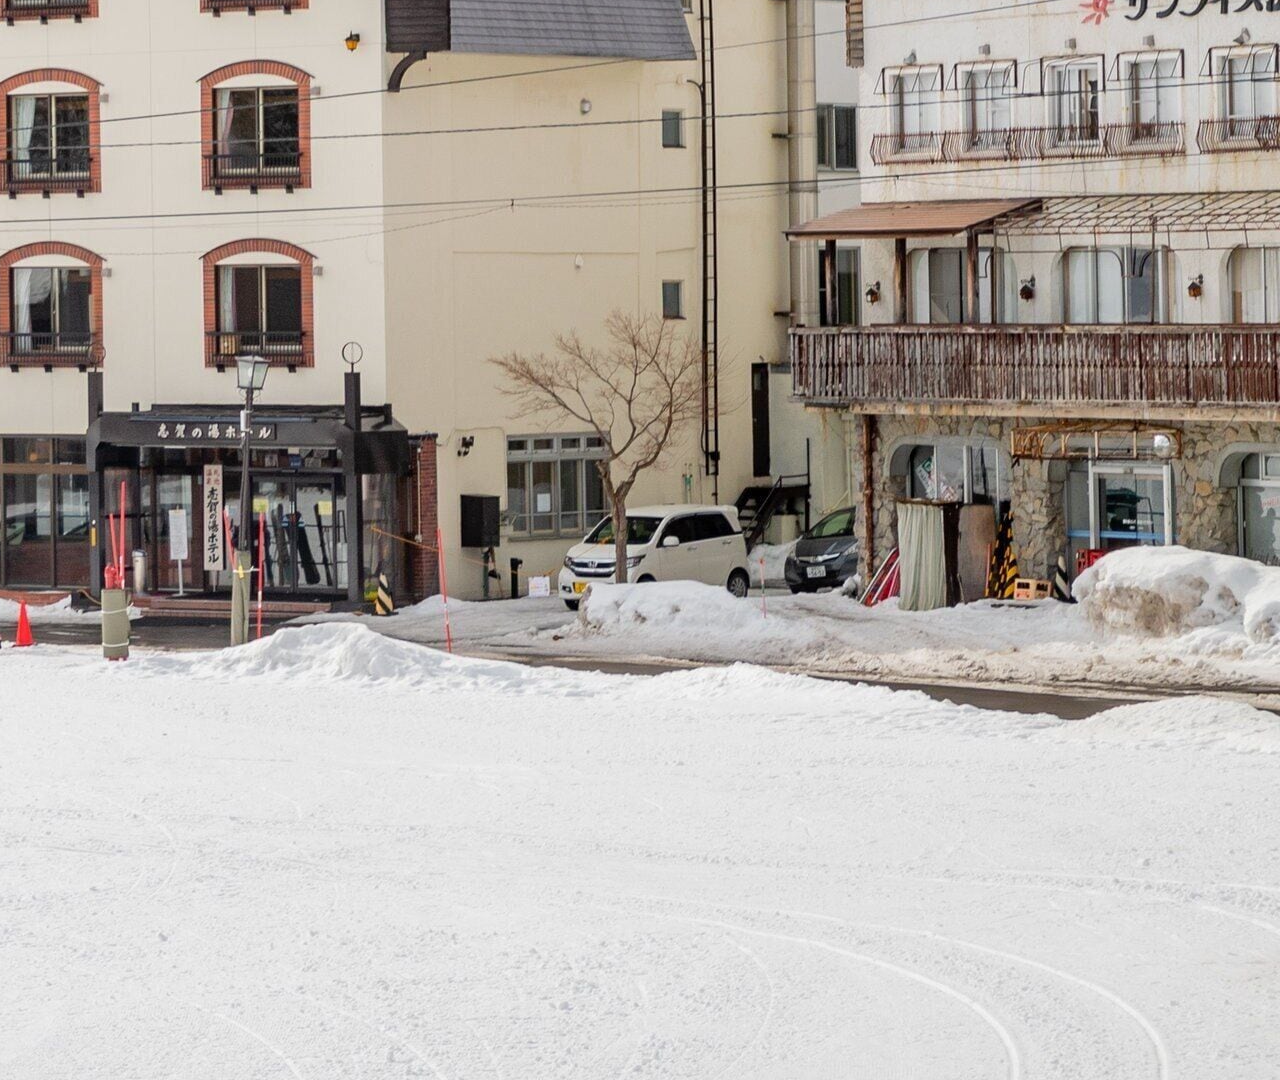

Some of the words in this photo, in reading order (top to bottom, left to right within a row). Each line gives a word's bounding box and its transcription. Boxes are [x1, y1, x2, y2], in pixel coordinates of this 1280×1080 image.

[207, 487, 220, 564] 志賀の湯ホテル
